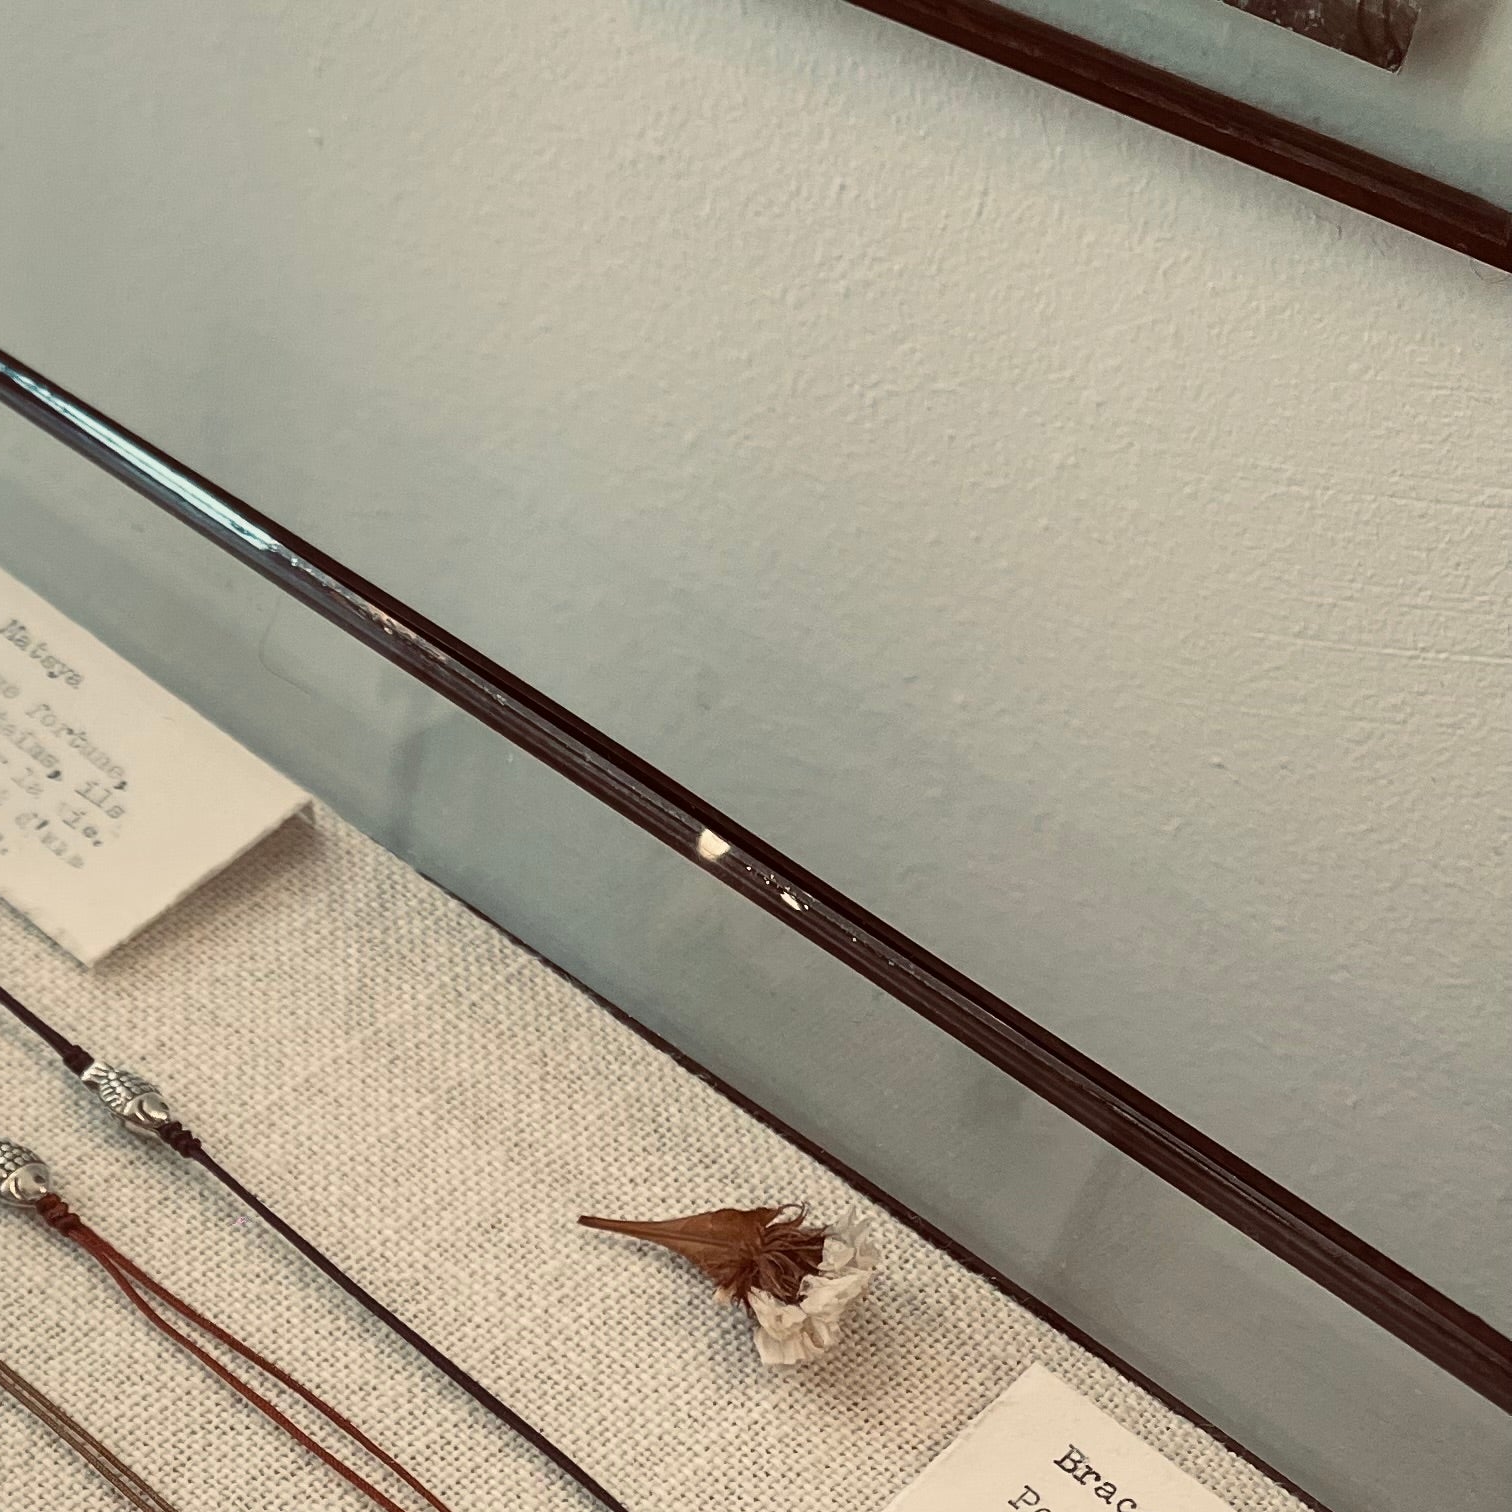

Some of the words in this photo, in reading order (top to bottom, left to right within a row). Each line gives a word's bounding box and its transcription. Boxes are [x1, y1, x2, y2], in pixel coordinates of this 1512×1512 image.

[24, 702, 128, 792] fortune,
[10, 766, 44, 799] la
[73, 780, 127, 819] ils
